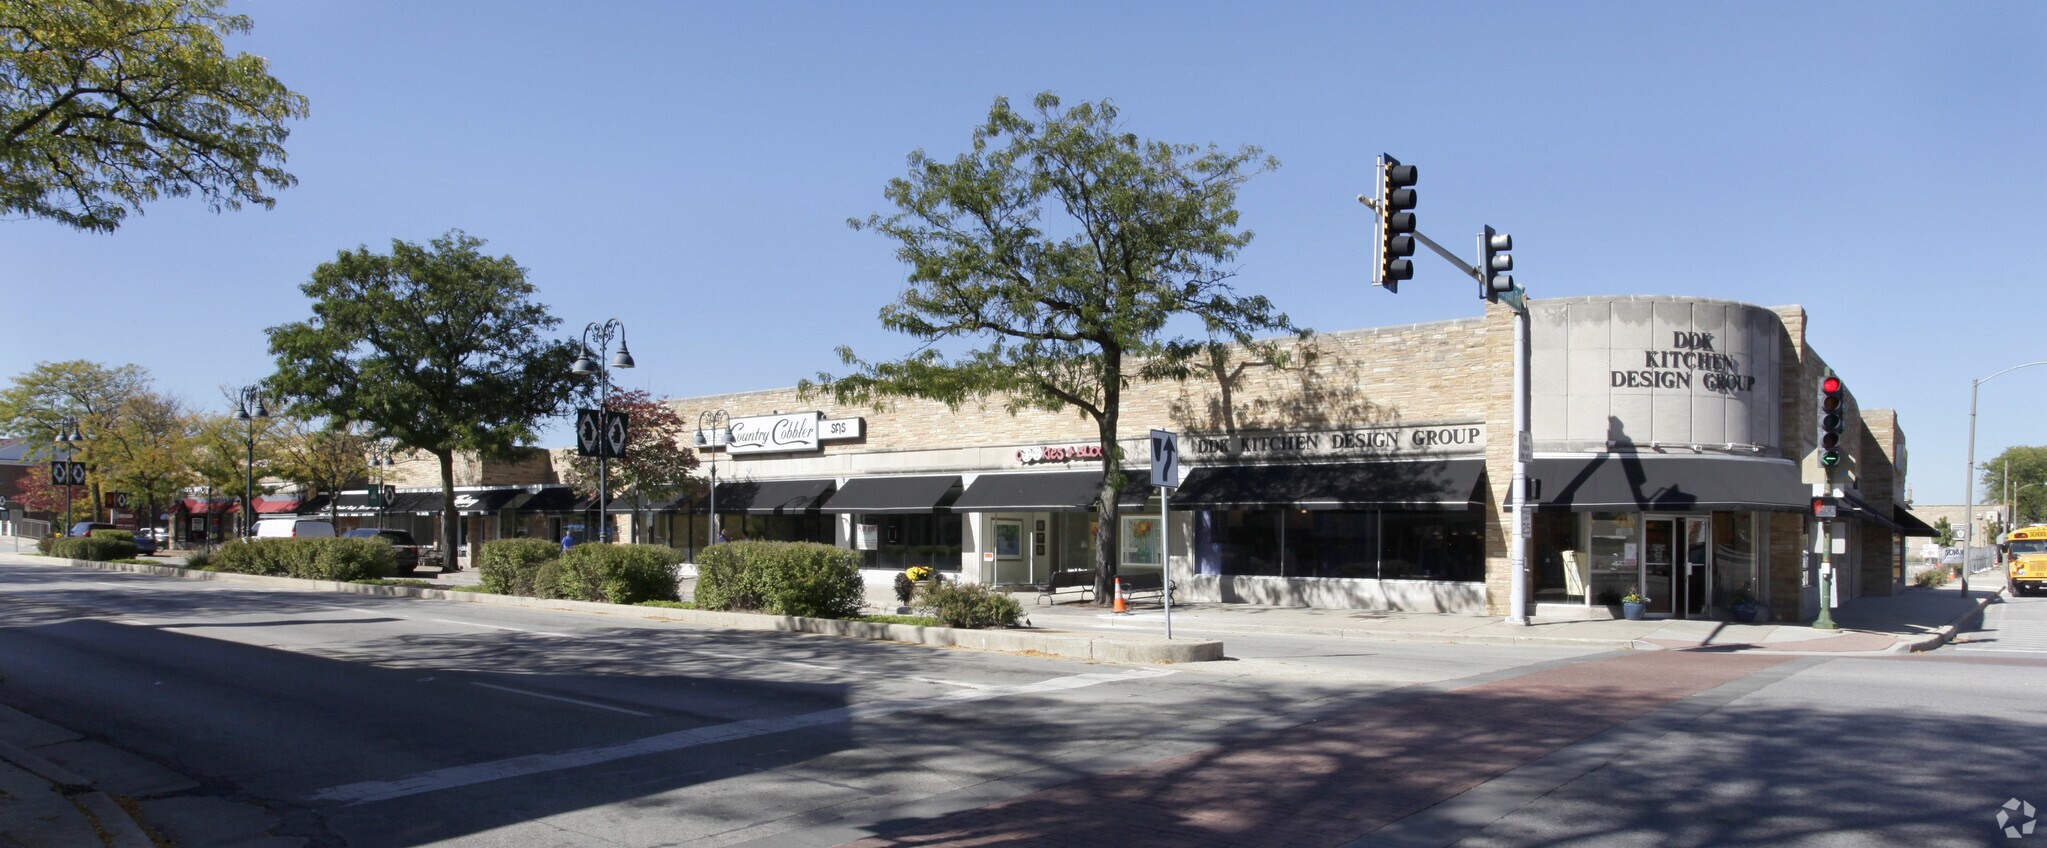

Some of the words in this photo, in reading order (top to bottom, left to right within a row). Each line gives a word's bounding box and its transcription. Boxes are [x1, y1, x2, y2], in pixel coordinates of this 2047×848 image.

[1673, 331, 1714, 351] DDK
[1645, 350, 1734, 371] KITCHEN
[1611, 370, 1691, 388] DESIGN
[1703, 372, 1755, 392] GROUP
[731, 422, 769, 447] Country
[772, 418, 814, 446] Cobbler
[831, 422, 846, 435] SAS
[1198, 439, 1229, 453] DDK
[1241, 435, 1318, 452] KITCHEN
[1332, 431, 1399, 449] DESIGN
[1411, 427, 1480, 446] GROUP
[1522, 522, 1531, 535] 25
